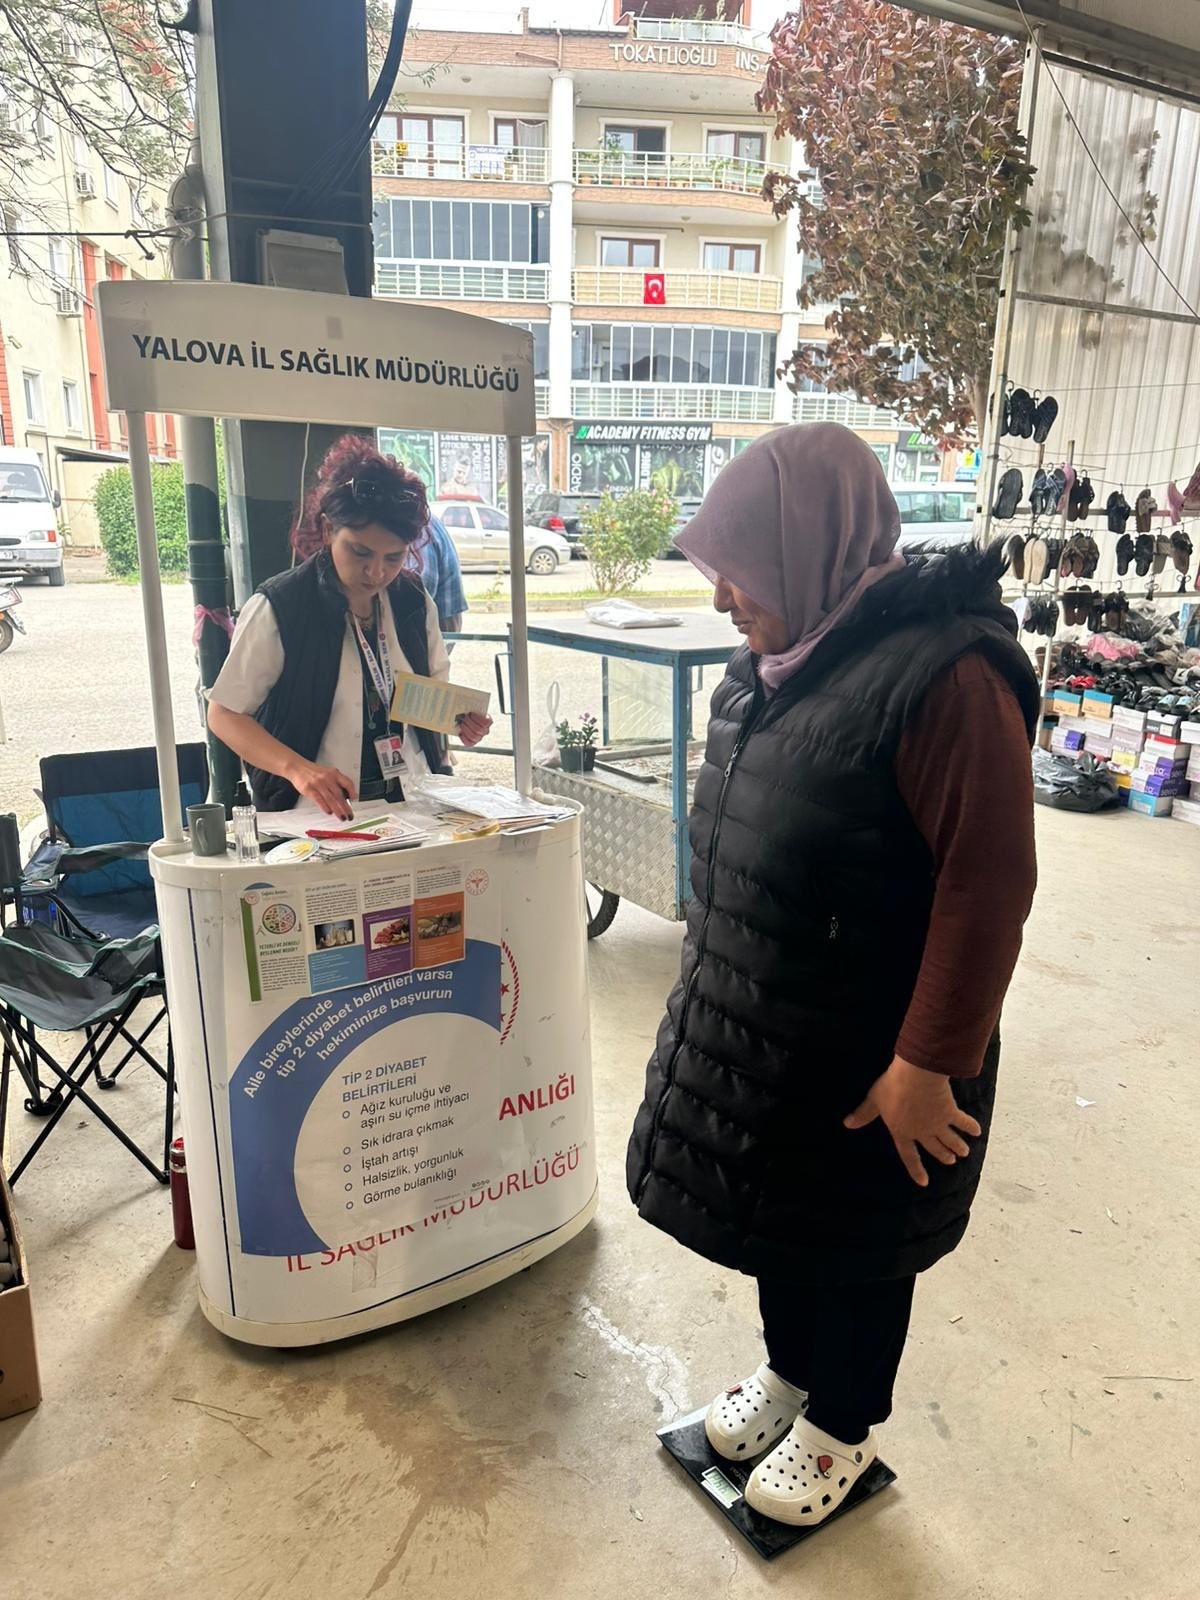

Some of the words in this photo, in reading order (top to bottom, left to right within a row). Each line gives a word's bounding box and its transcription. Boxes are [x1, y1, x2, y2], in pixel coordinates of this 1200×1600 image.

[608, 43, 717, 66] TOKATLIOĞLU
[133, 335, 245, 367] YALOVA
[252, 341, 274, 370] İL
[280, 348, 370, 378] SAĞLIK
[375, 356, 519, 392] MÜDÜRLÜĞÜ
[586, 425, 641, 440] ACADEMY
[640, 426, 686, 440] FITNESS
[686, 427, 711, 441] GYM
[276, 1059, 296, 1077] tip
[292, 1046, 306, 1059] 2
[304, 1003, 353, 1048] diyabet
[352, 972, 413, 1008] belirtileri
[416, 970, 453, 981] varsa
[316, 1005, 388, 1061] hekiminize
[390, 989, 453, 1009] başvurun
[244, 1070, 266, 1098] Aile
[259, 999, 333, 1069] bireylerinde
[342, 1071, 362, 1086] TİP
[365, 1069, 373, 1081] 2
[375, 1056, 427, 1078] DİYABET
[342, 1073, 417, 1103] BELİRTİLERİ
[360, 1101, 386, 1116] Ağız
[389, 1087, 436, 1108] kuruluğu
[438, 1083, 451, 1094] ve
[360, 1115, 385, 1129] aşırı
[388, 1110, 402, 1121] su
[404, 1102, 431, 1118] içme
[433, 1091, 470, 1109] ihtiyacı
[361, 1137, 380, 1150] Sık
[382, 1128, 414, 1144] idrara
[416, 1115, 455, 1137] çıkmak
[361, 1153, 389, 1171] İştah
[391, 1145, 419, 1161] artışı
[362, 1164, 411, 1187] Halsizlik,
[413, 1147, 465, 1174] yorgunluk
[363, 1185, 401, 1205] Görme
[403, 1167, 458, 1192] bulanıklığı
